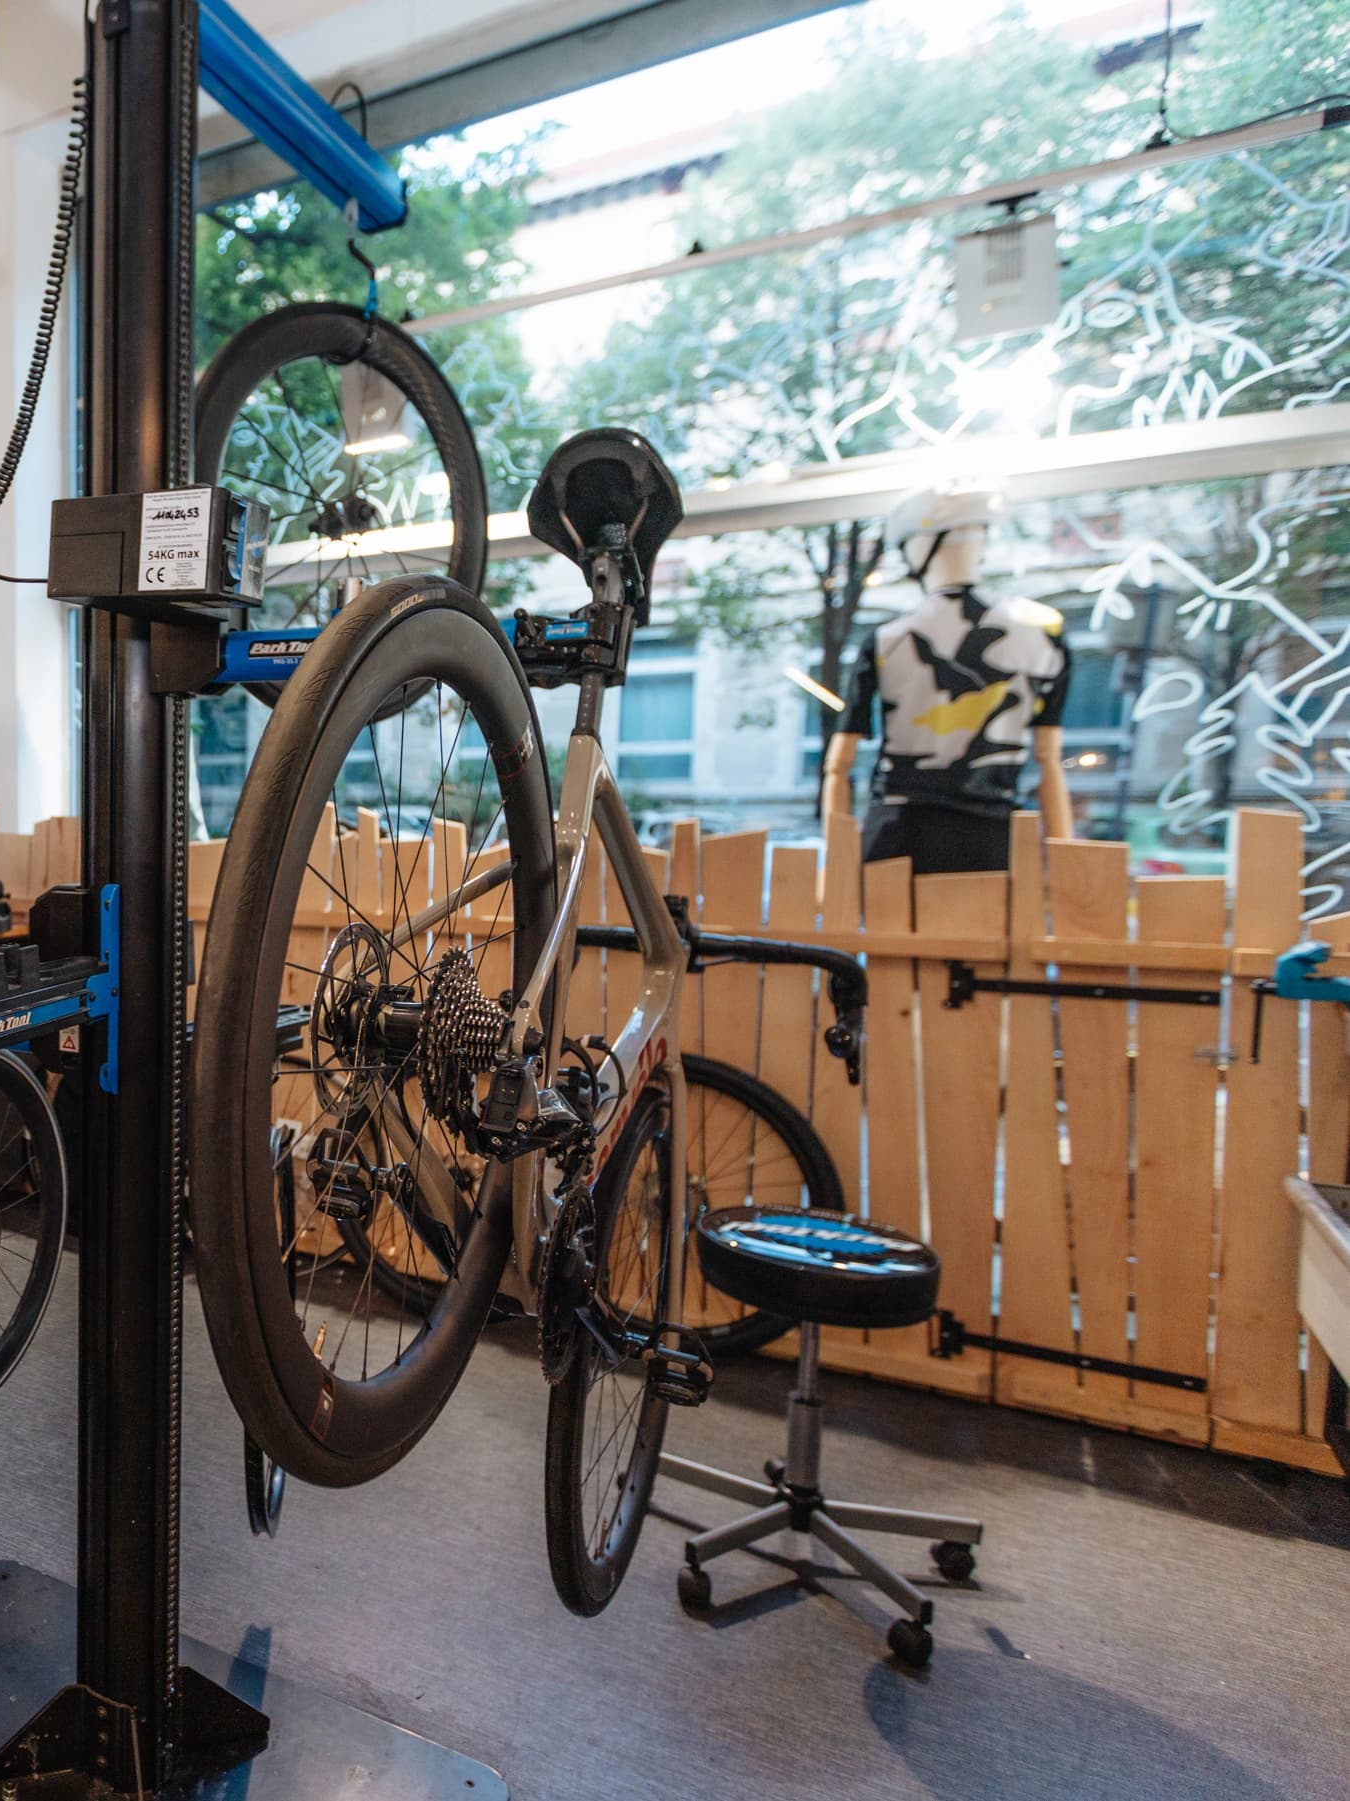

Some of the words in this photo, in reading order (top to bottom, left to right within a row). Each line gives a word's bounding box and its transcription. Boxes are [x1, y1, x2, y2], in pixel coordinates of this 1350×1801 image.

[147, 549, 175, 561] 54KG
[177, 550, 200, 559] max
[250, 642, 288, 655] Park
